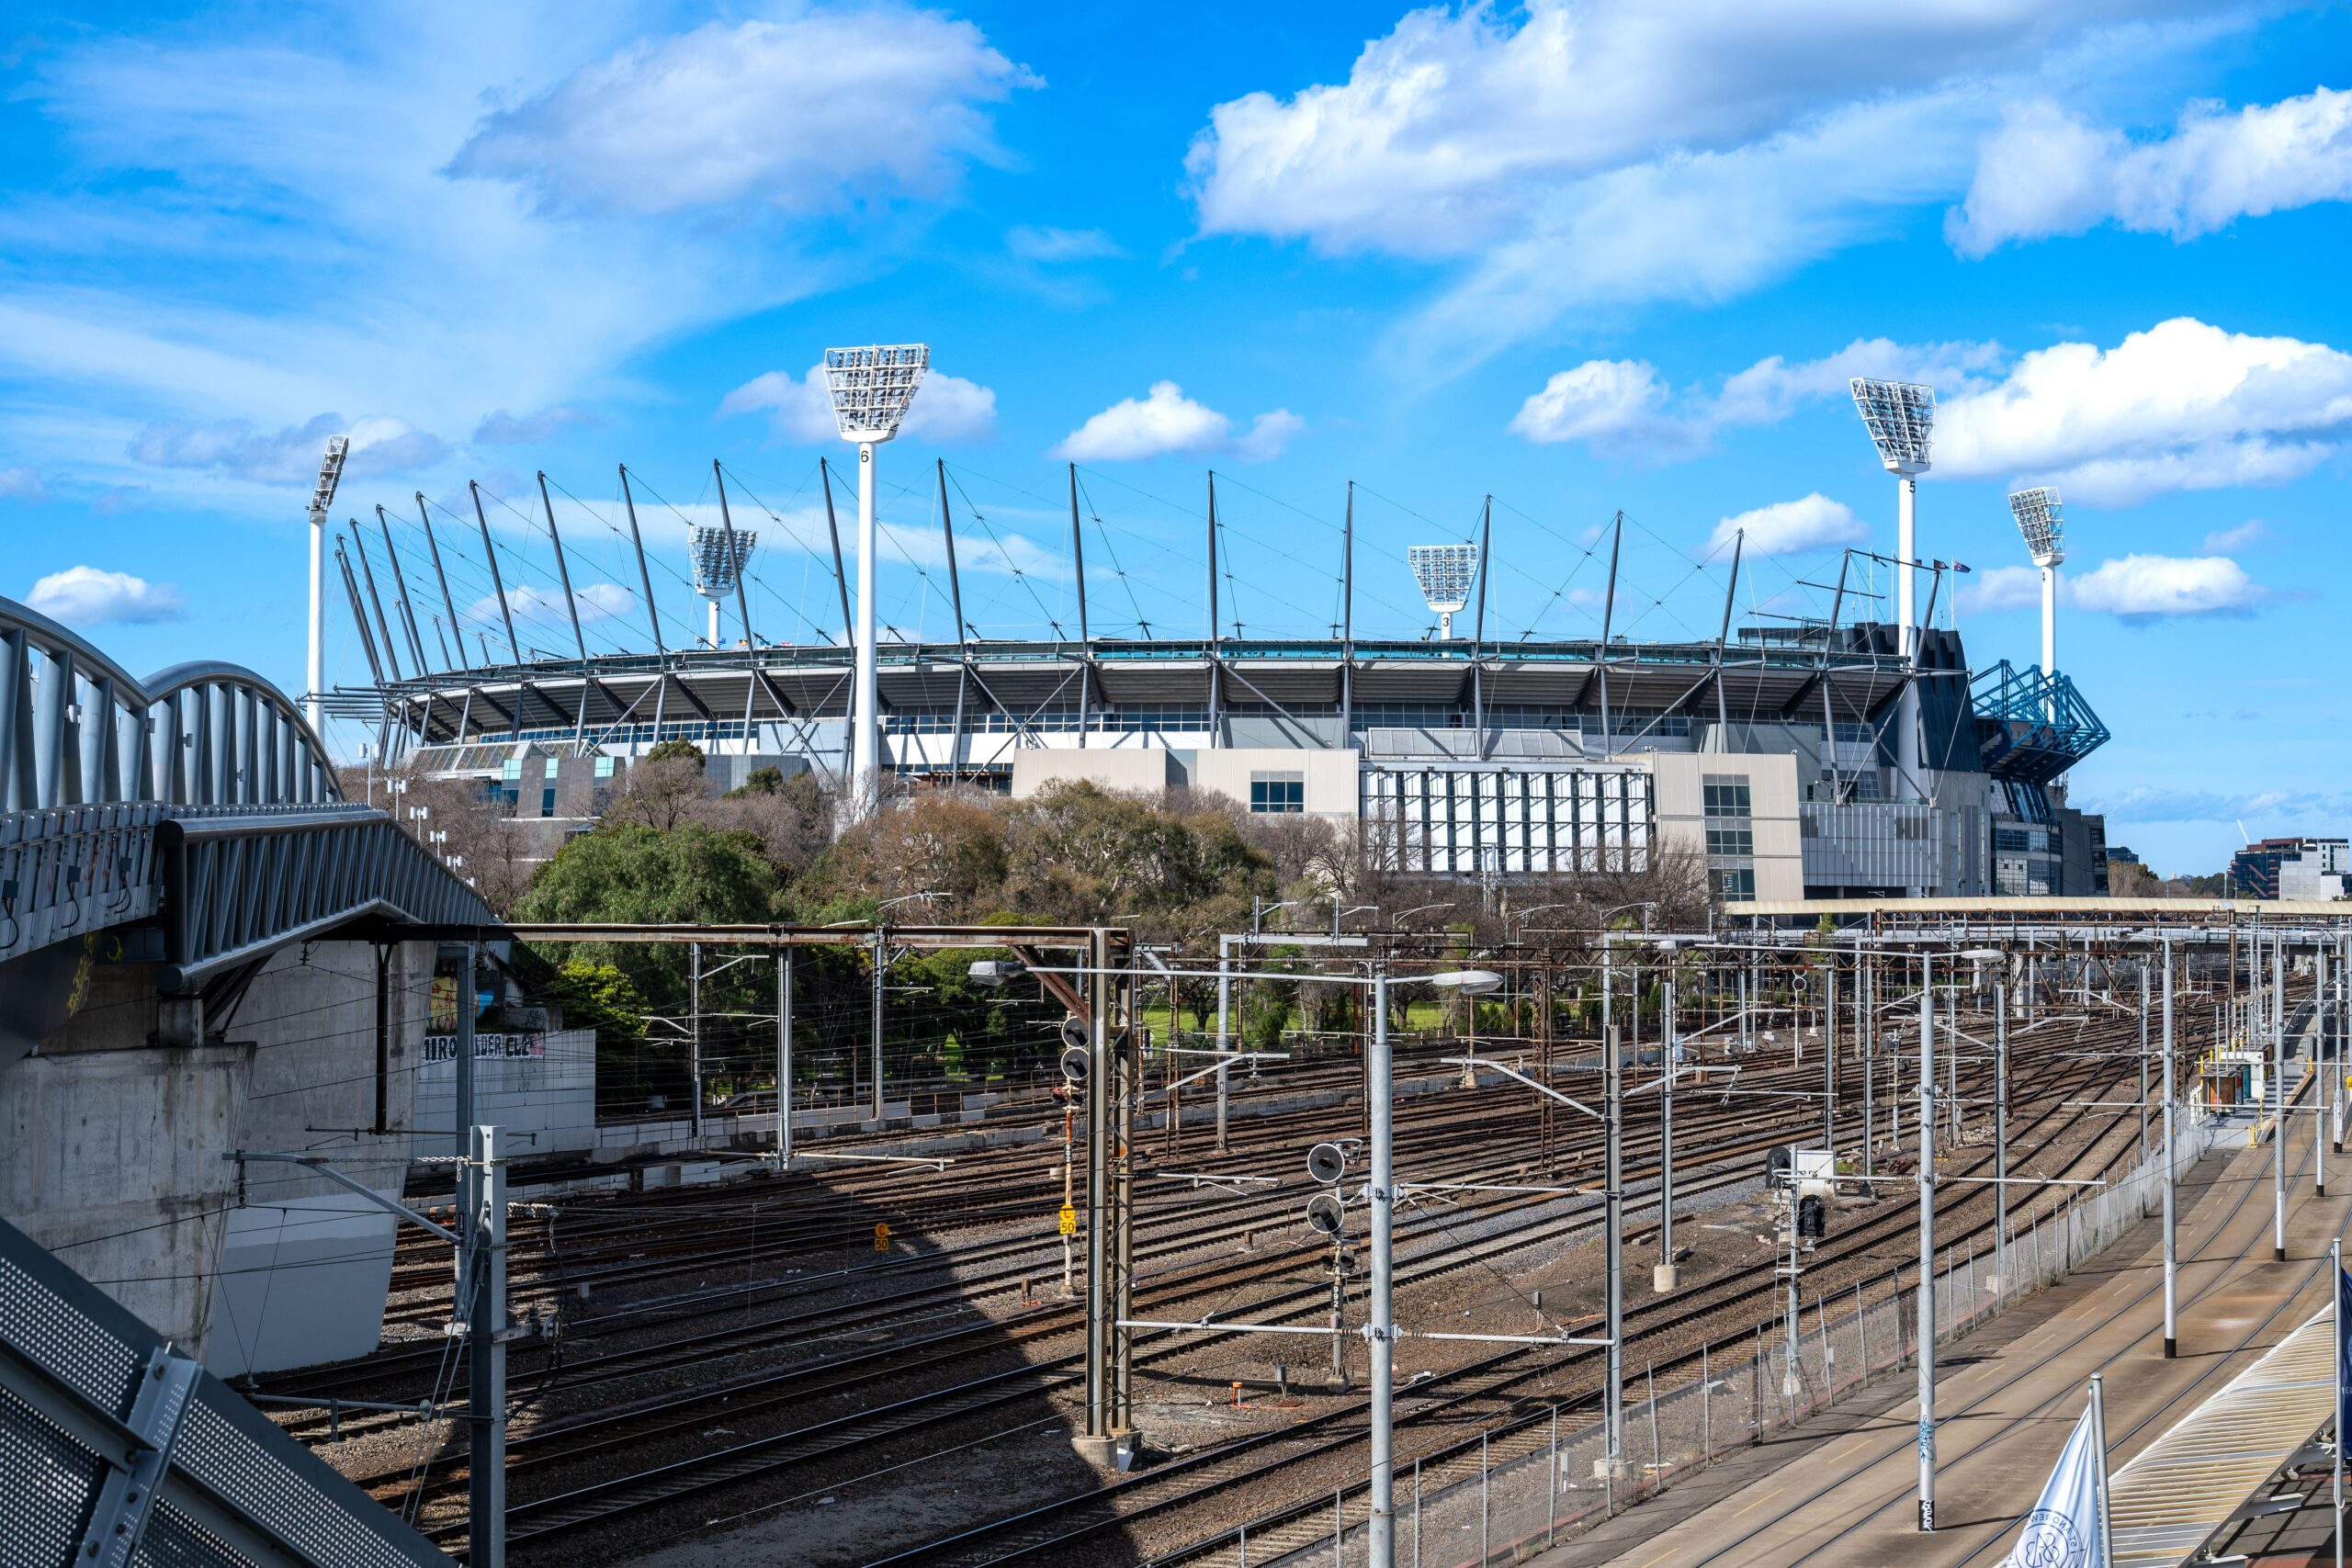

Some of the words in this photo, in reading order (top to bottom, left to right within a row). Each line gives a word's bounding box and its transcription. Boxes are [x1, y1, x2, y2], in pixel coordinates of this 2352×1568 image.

[861, 450, 869, 463] 6
[1909, 480, 1916, 493] 5
[715, 602, 720, 611] 2
[1442, 616, 1449, 626] 3
[878, 1224, 885, 1235] C
[1061, 1222, 1075, 1232] 50
[876, 1239, 888, 1249] 50
